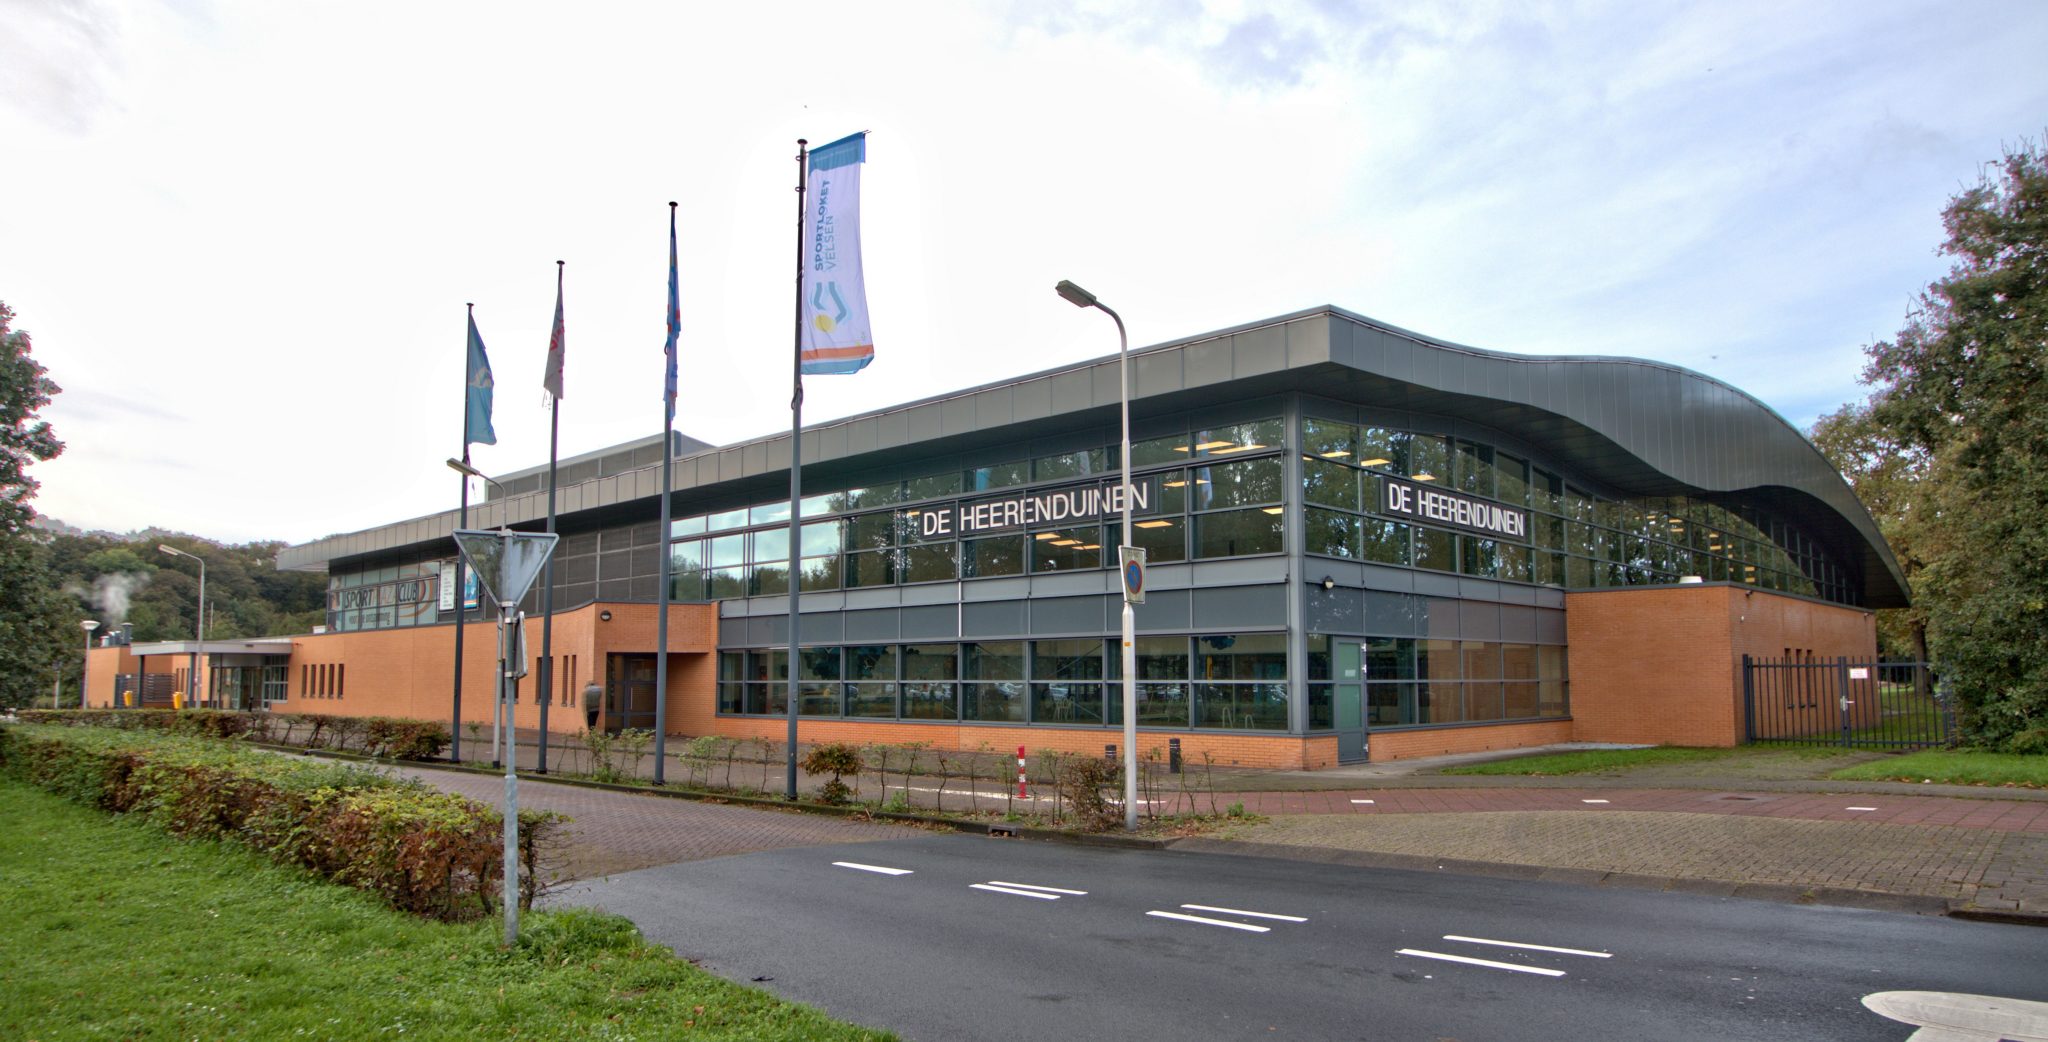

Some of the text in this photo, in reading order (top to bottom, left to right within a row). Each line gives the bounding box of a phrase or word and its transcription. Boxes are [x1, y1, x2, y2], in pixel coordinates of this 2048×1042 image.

[815, 180, 831, 271] SPORTLOKET
[824, 215, 837, 271] VELSEN
[923, 482, 1147, 536] DE HEERENDUINEN
[1388, 483, 1524, 537] DE HEERENDUINEN
